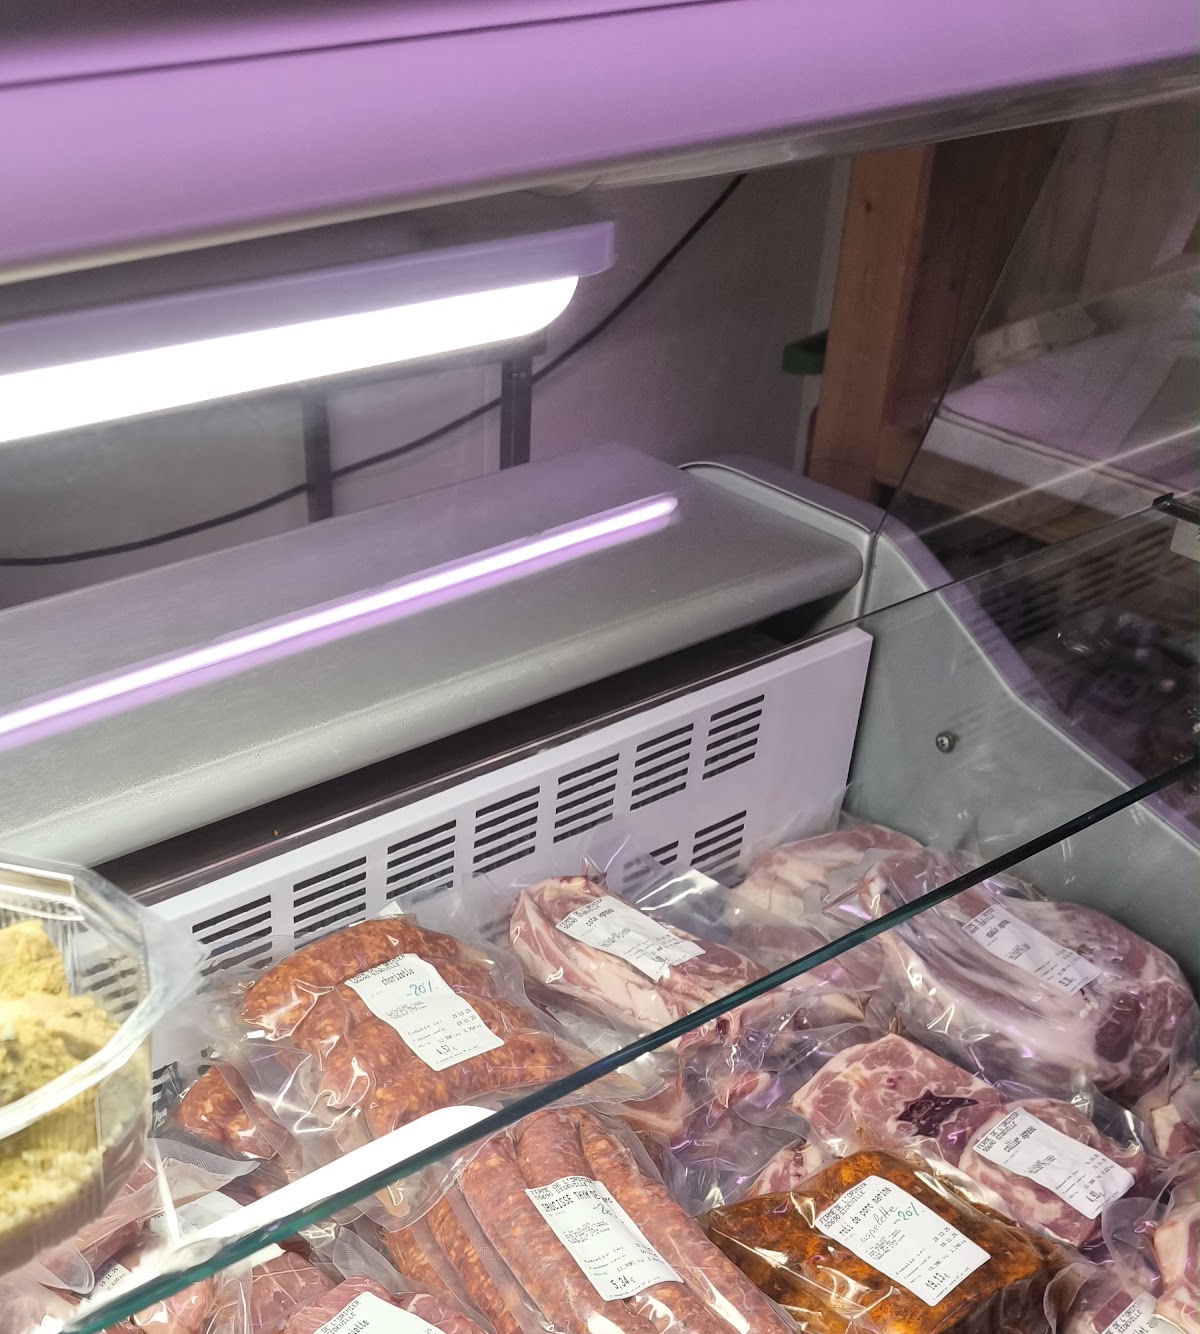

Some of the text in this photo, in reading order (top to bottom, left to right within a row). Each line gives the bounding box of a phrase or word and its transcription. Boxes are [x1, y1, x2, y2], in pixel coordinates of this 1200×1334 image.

[1003, 1137, 1020, 1153] collier
[852, 1215, 862, 1225] de
[860, 1203, 872, 1219] porc
